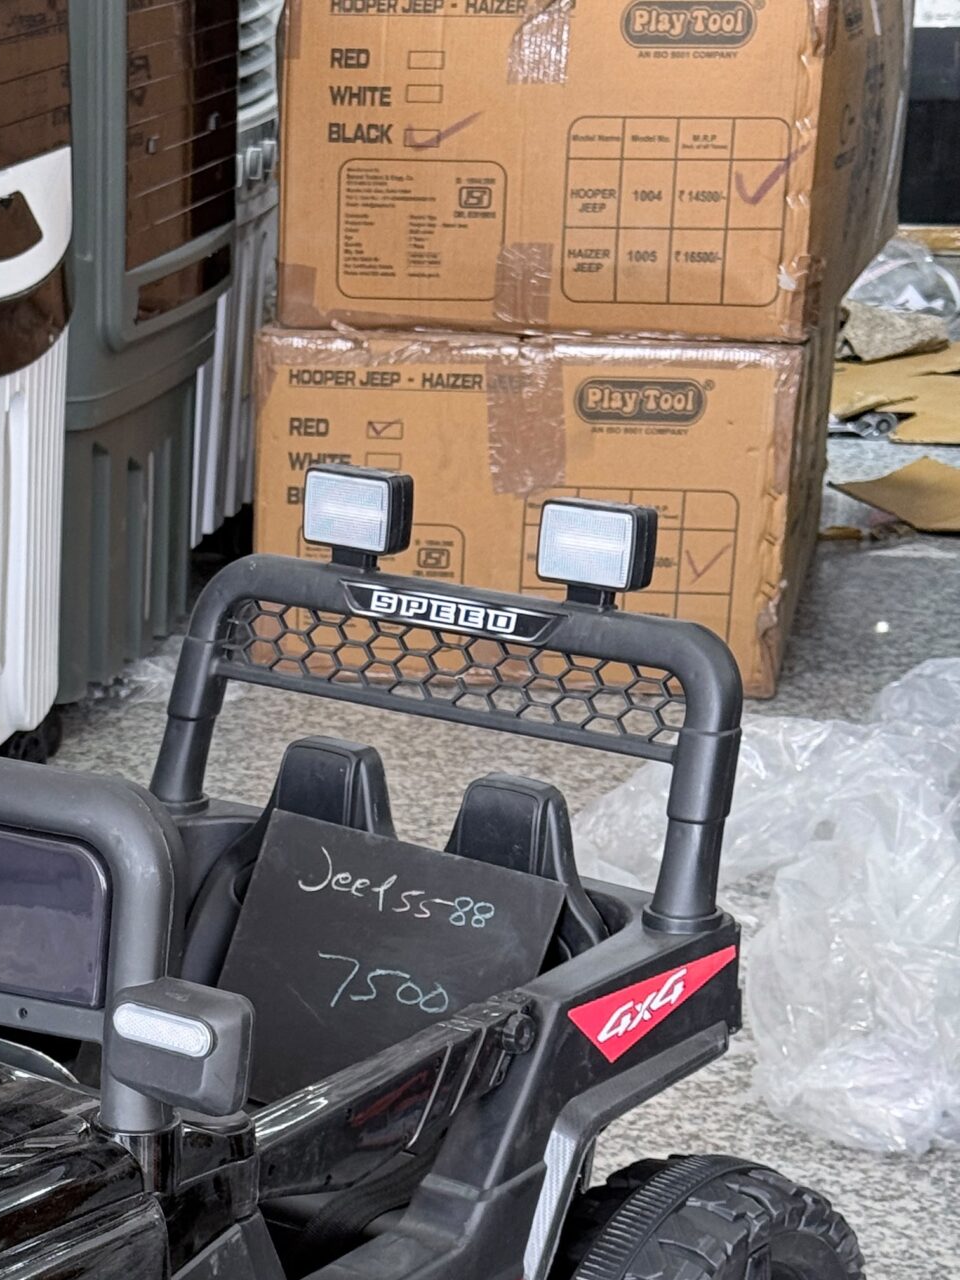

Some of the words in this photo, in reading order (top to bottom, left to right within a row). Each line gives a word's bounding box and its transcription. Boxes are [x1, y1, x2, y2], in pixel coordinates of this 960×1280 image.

[633, 9, 686, 37] Play
[692, 8, 744, 33] Tool
[330, 48, 370, 69] RED
[692, 51, 738, 60] COMPANY
[329, 85, 392, 107] WHITE
[328, 122, 394, 145] BLACK
[570, 188, 617, 200] HOOPER
[632, 190, 663, 202] 1004
[578, 203, 607, 214] JEEP
[567, 249, 611, 260] HAIZER
[627, 250, 658, 263] 1005
[573, 263, 604, 273] JEEP
[289, 368, 356, 386] HOOPER
[359, 371, 401, 388] JEEP
[421, 373, 484, 390] HAIZER
[587, 388, 639, 415] Play
[643, 389, 695, 413] Tool
[289, 418, 330, 437] RED
[370, 590, 518, 634] SPEED
[317, 950, 449, 1014] 7500
